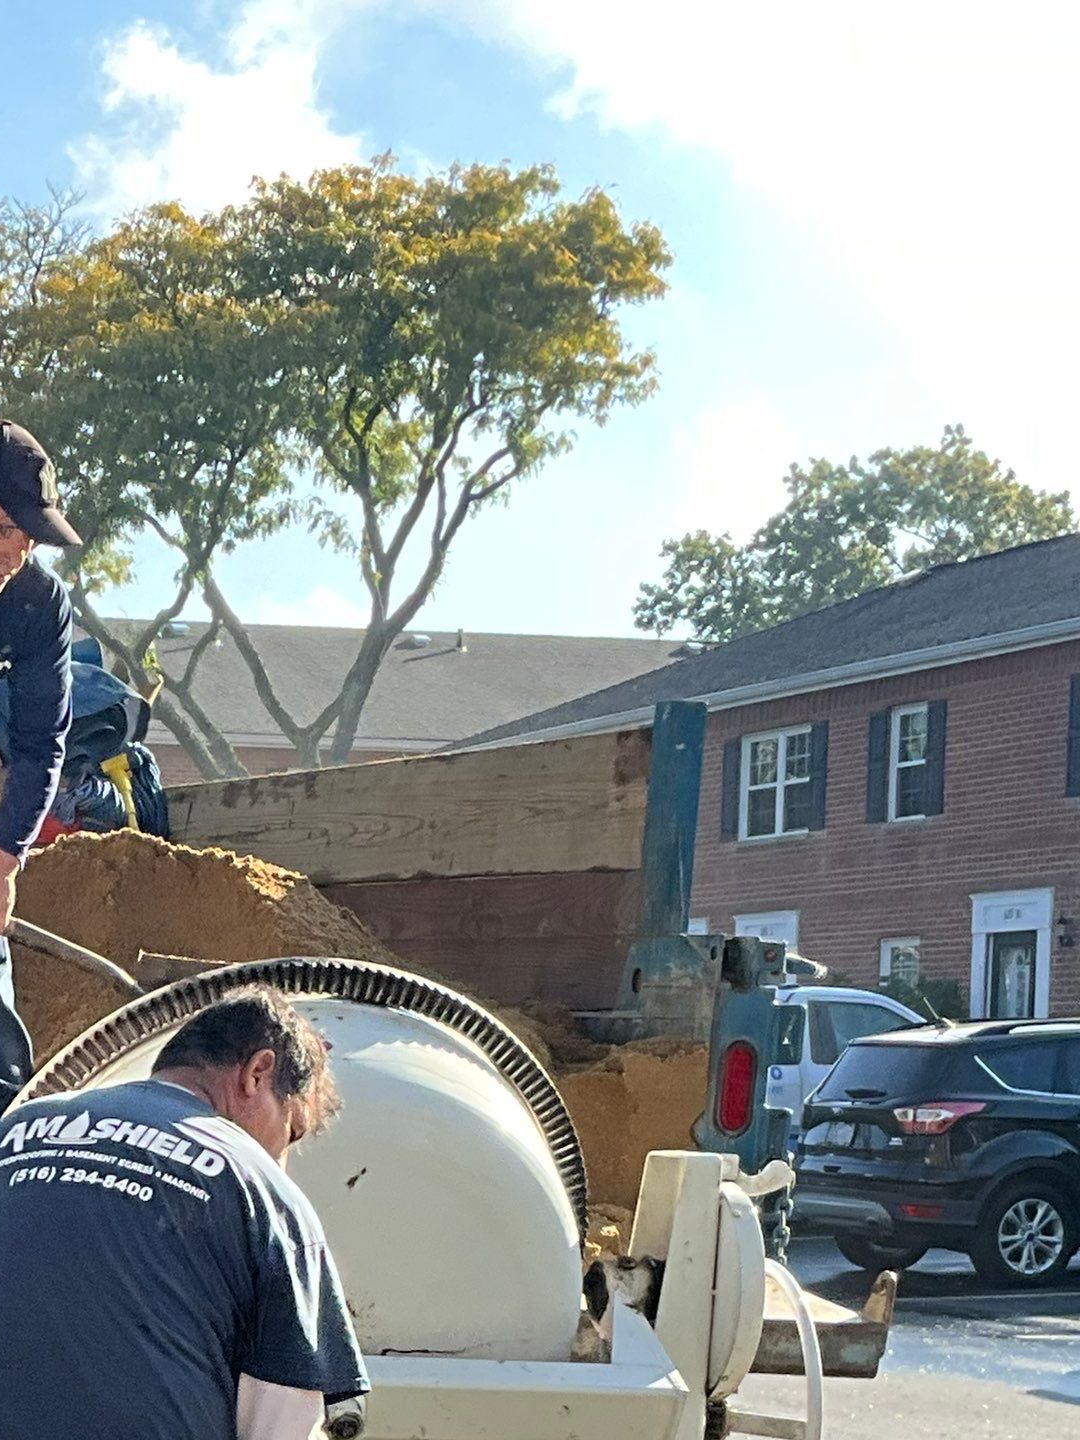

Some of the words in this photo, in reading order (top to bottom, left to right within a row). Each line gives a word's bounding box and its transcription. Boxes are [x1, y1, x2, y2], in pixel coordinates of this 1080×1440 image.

[9, 1166, 57, 1187] (516)
[59, 1167, 154, 1201] 294-8400
[65, 1149, 118, 1165] BASEMENT
[161, 1172, 211, 1202] MASONRY
